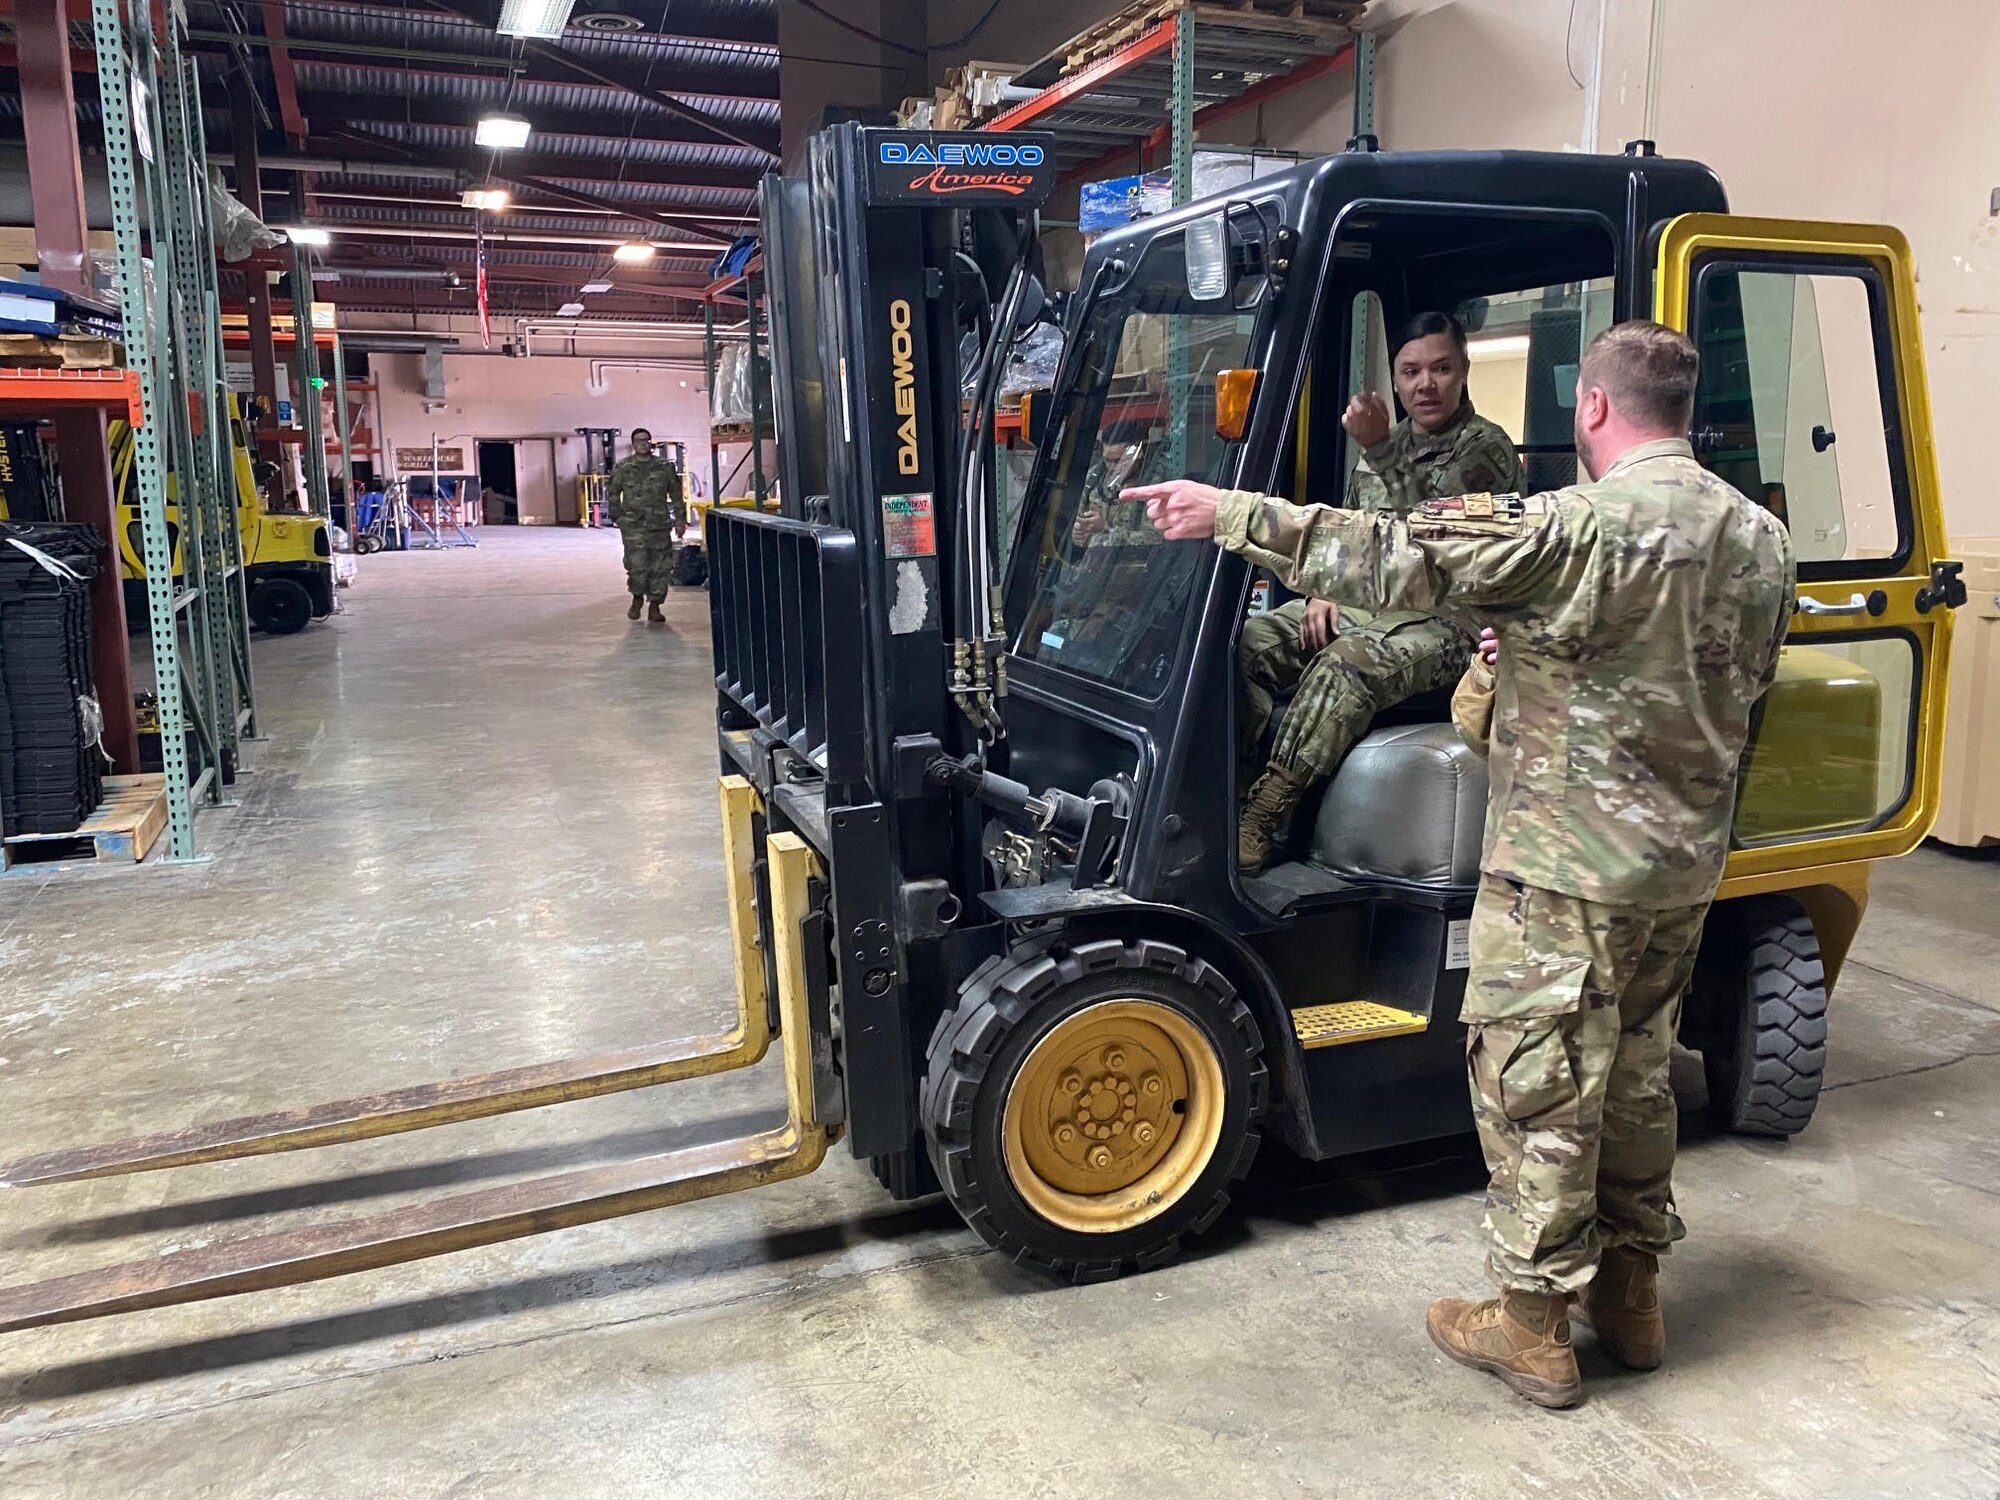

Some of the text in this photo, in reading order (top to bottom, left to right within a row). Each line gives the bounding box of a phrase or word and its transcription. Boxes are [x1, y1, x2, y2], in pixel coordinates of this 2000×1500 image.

[880, 143, 1044, 166] DAEWOO
[909, 166, 1034, 195] America
[890, 299, 919, 475] DAEWOO
[885, 500, 928, 510] INDEPENDENT
